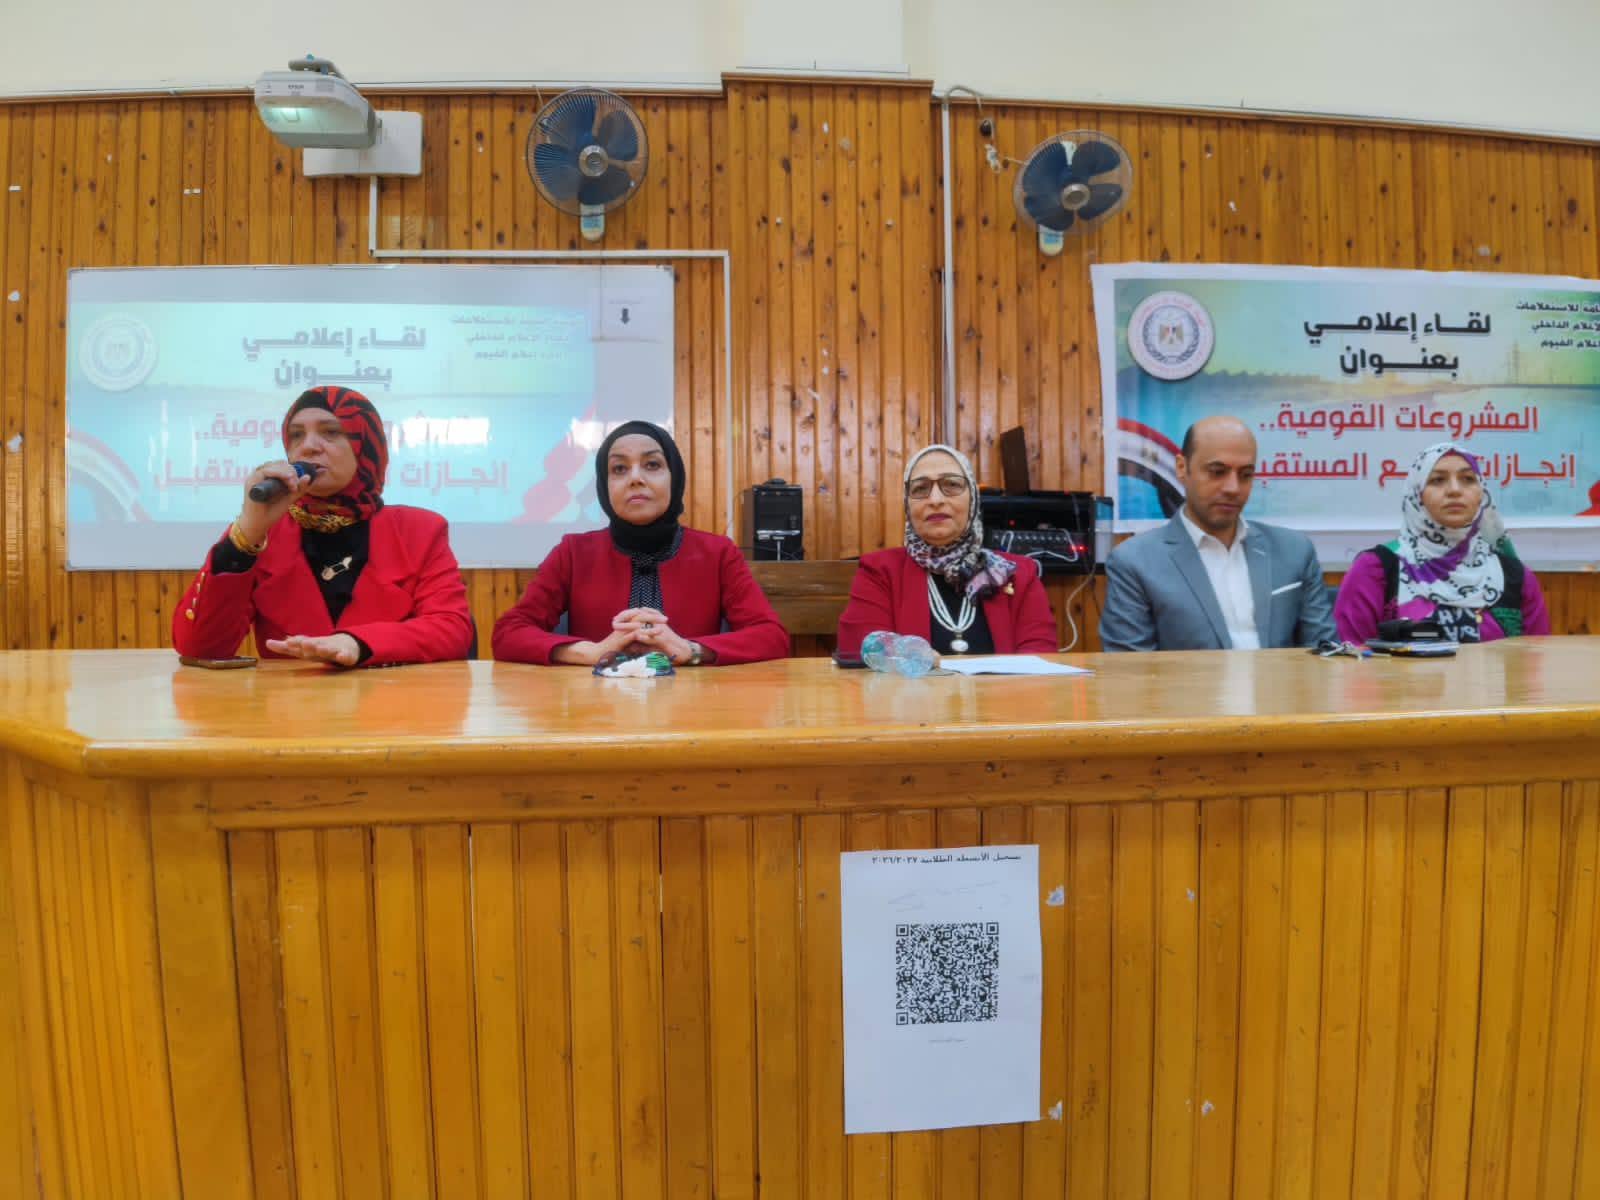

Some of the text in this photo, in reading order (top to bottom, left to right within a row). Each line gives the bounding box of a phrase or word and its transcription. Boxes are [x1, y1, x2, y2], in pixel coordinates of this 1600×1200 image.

[242, 325, 427, 361] لقاء إعلامي
[1303, 311, 1492, 345] لقاء إعلامي
[274, 359, 393, 391] بعنوان
[1339, 346, 1458, 377] بعنوان
[1395, 401, 1538, 438] المشروعات
[1254, 452, 1367, 488] المستقب
